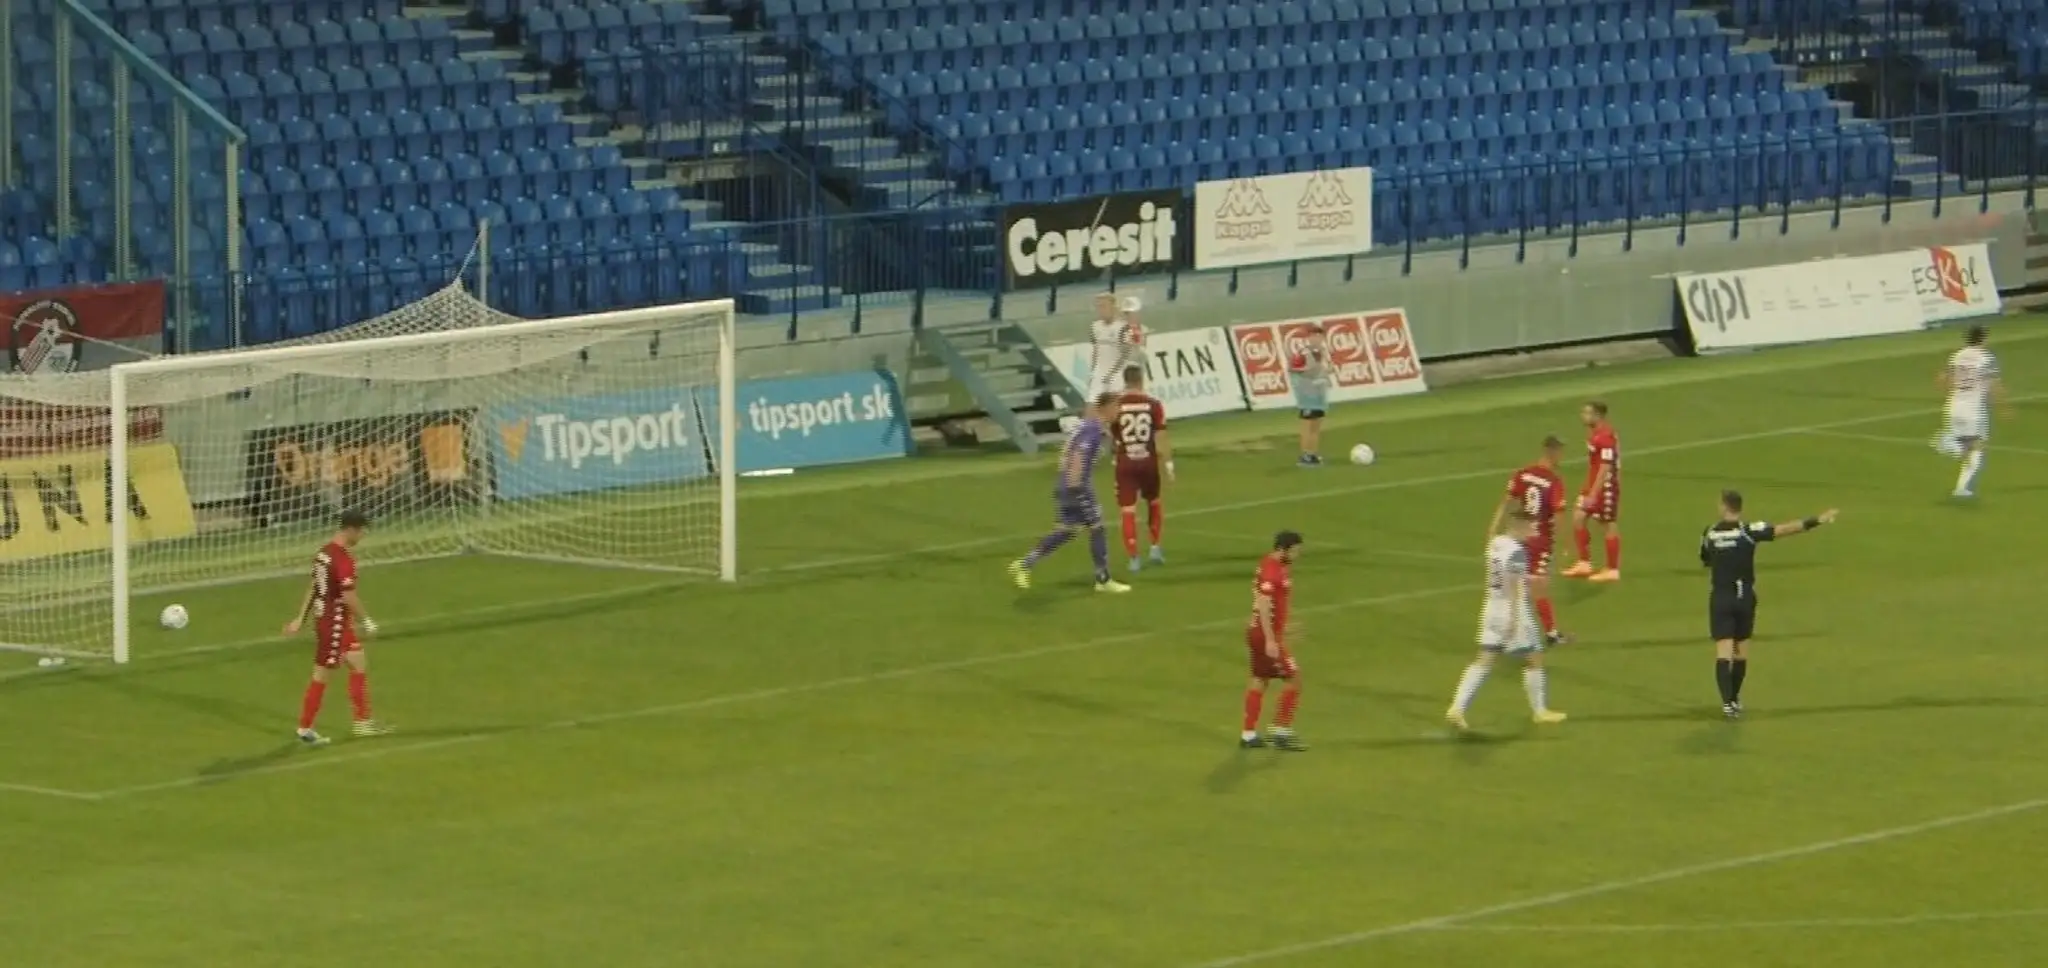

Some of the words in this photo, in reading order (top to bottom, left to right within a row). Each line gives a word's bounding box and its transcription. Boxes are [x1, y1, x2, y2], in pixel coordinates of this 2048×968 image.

[1215, 219, 1273, 240] Kappa
[1297, 210, 1353, 231] Kappa
[1008, 200, 1178, 277] Ceresit
[1332, 332, 1358, 351] CBA
[1375, 326, 1400, 346] CBA
[1246, 341, 1271, 360] CBA
[537, 404, 688, 469] Tipsport
[1119, 413, 1153, 443] 26
[275, 441, 410, 488] Orange
